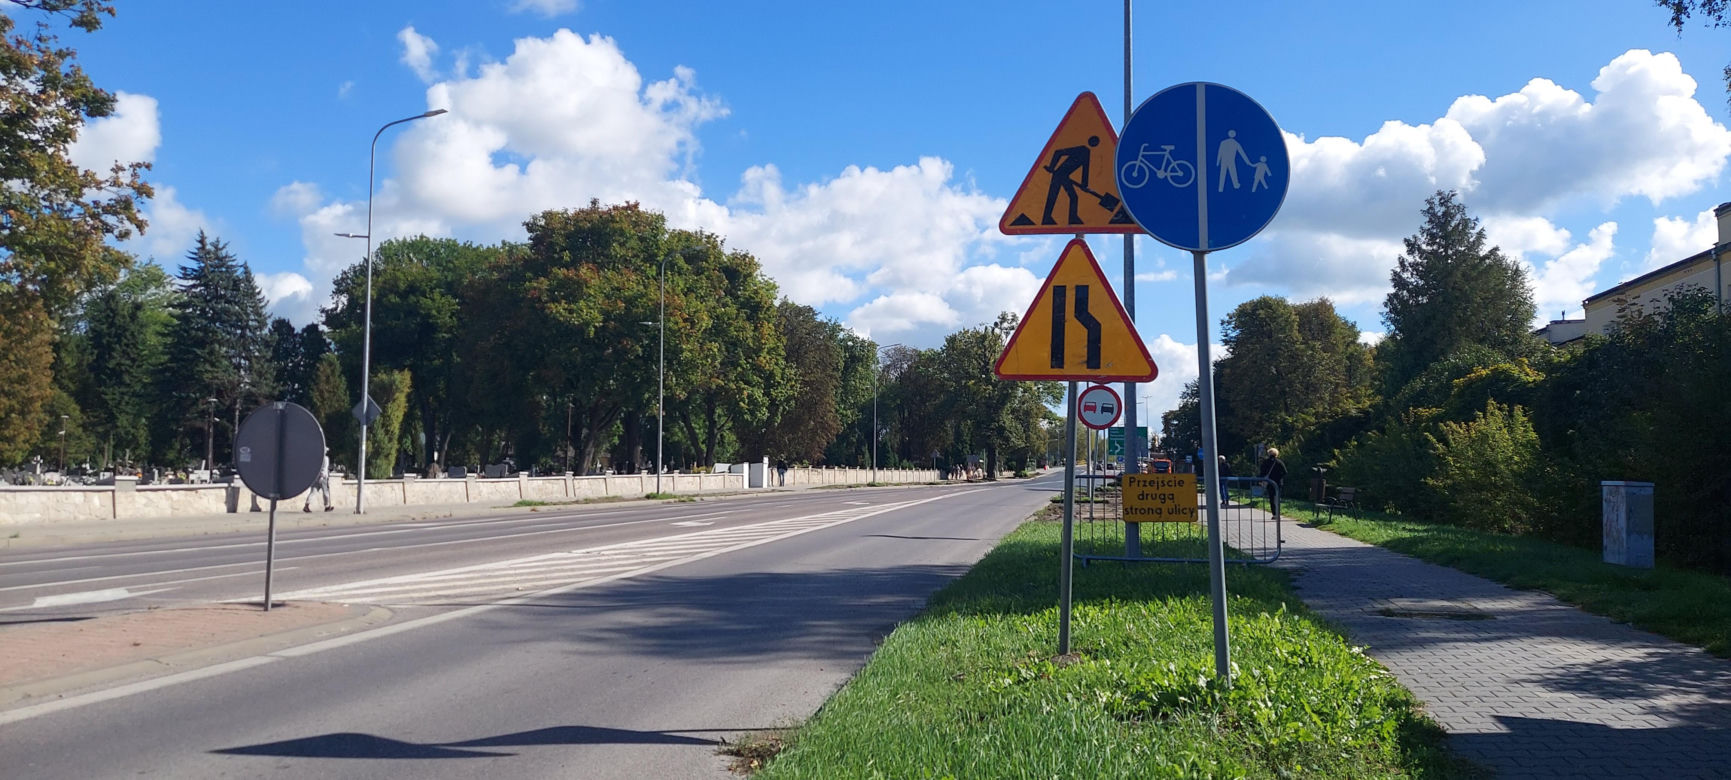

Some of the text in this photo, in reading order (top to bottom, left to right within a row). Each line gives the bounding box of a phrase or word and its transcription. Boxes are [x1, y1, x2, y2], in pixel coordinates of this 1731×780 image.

[1137, 490, 1175, 504] drugą
[1124, 504, 1195, 518] stroną ulicy
